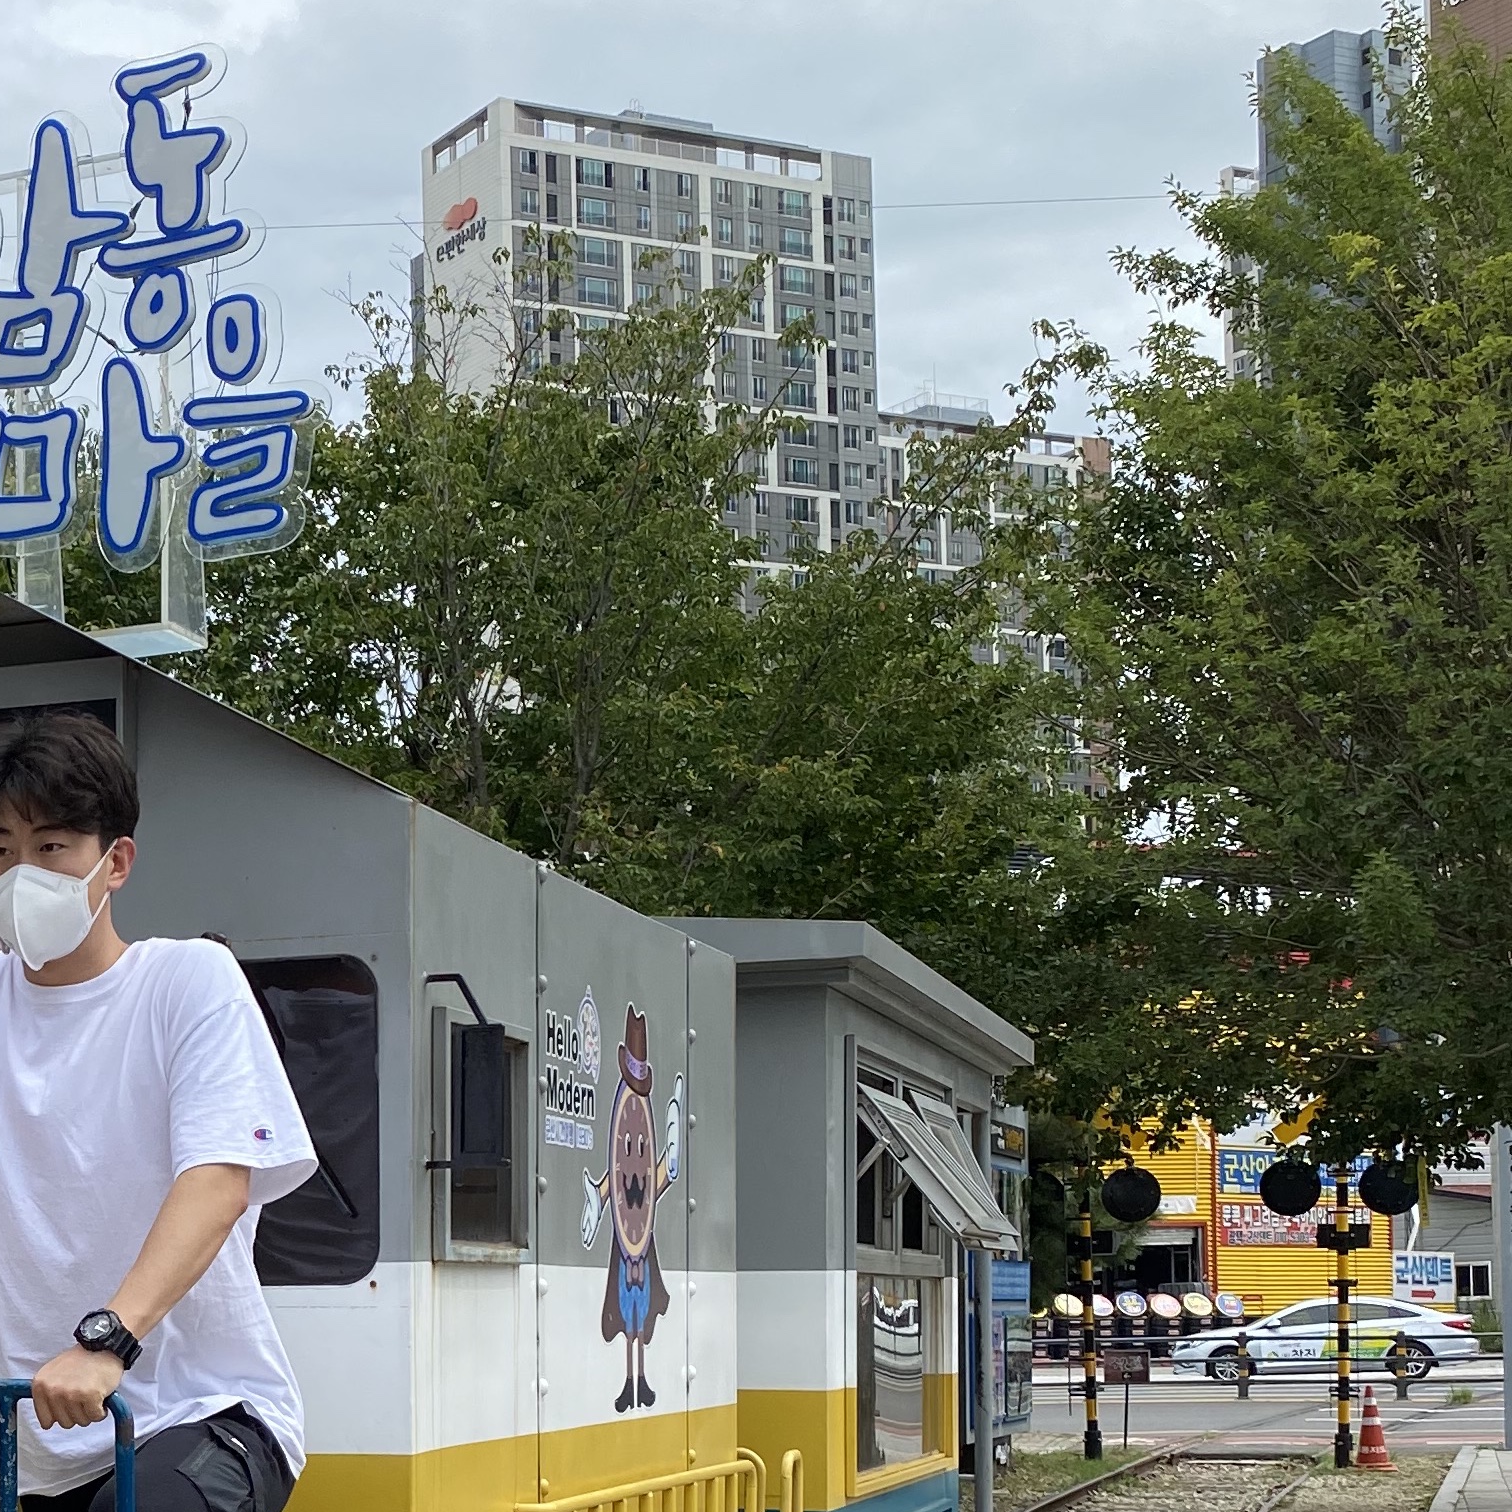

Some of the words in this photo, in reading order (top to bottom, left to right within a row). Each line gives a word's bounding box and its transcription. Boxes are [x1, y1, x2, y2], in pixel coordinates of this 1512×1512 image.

[436, 216, 487, 263] e편한세상
[545, 1064, 596, 1120] Modern
[1396, 1255, 1452, 1285] 군산덴트
